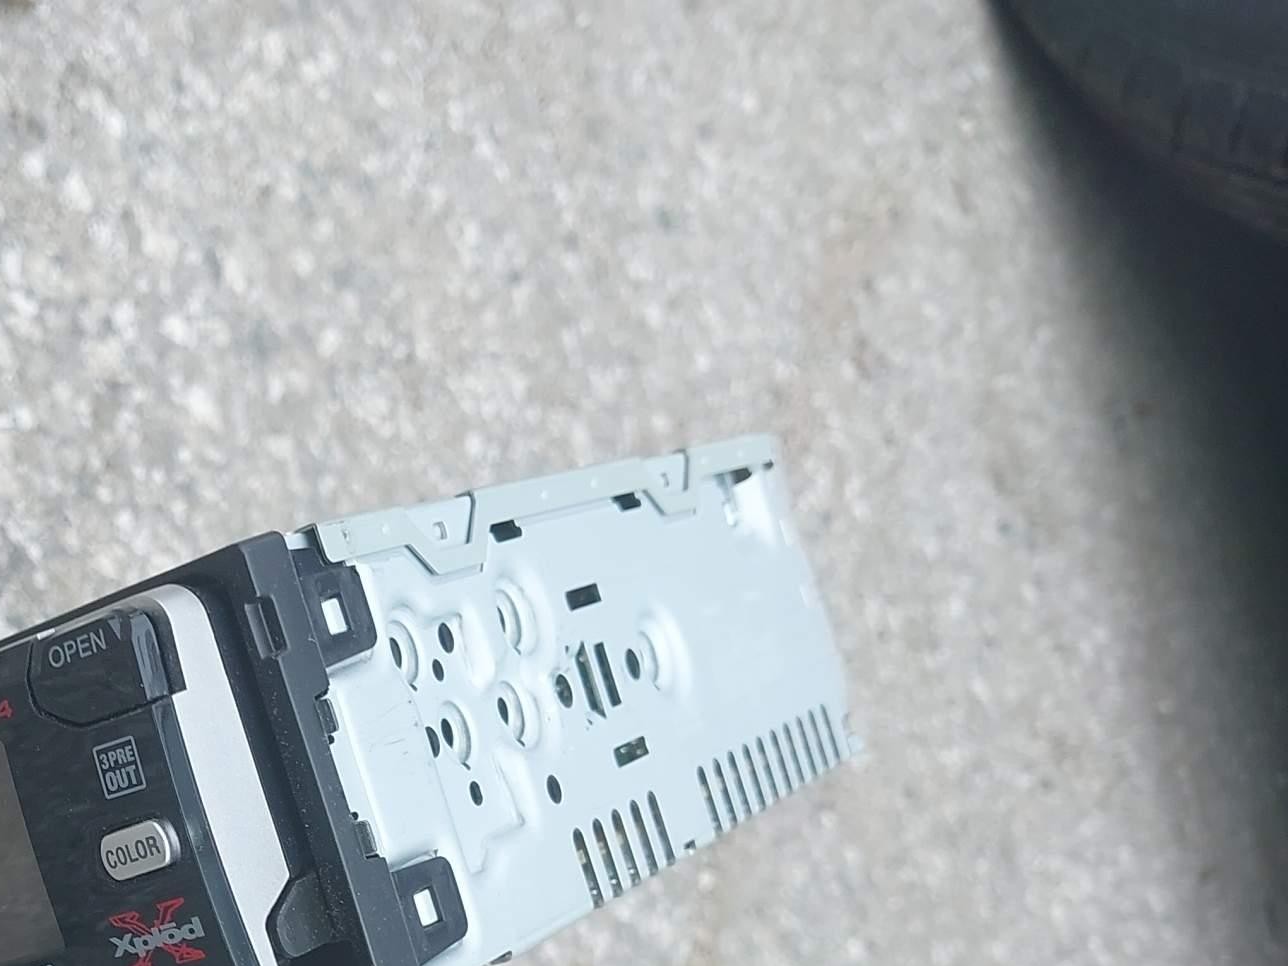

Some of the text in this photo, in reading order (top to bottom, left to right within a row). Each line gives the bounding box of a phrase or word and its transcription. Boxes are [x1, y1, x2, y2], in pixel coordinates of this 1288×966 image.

[48, 628, 107, 668] OPEN
[99, 745, 136, 770] 3PRE
[105, 764, 138, 792] OUT
[105, 835, 161, 870] COLOR
